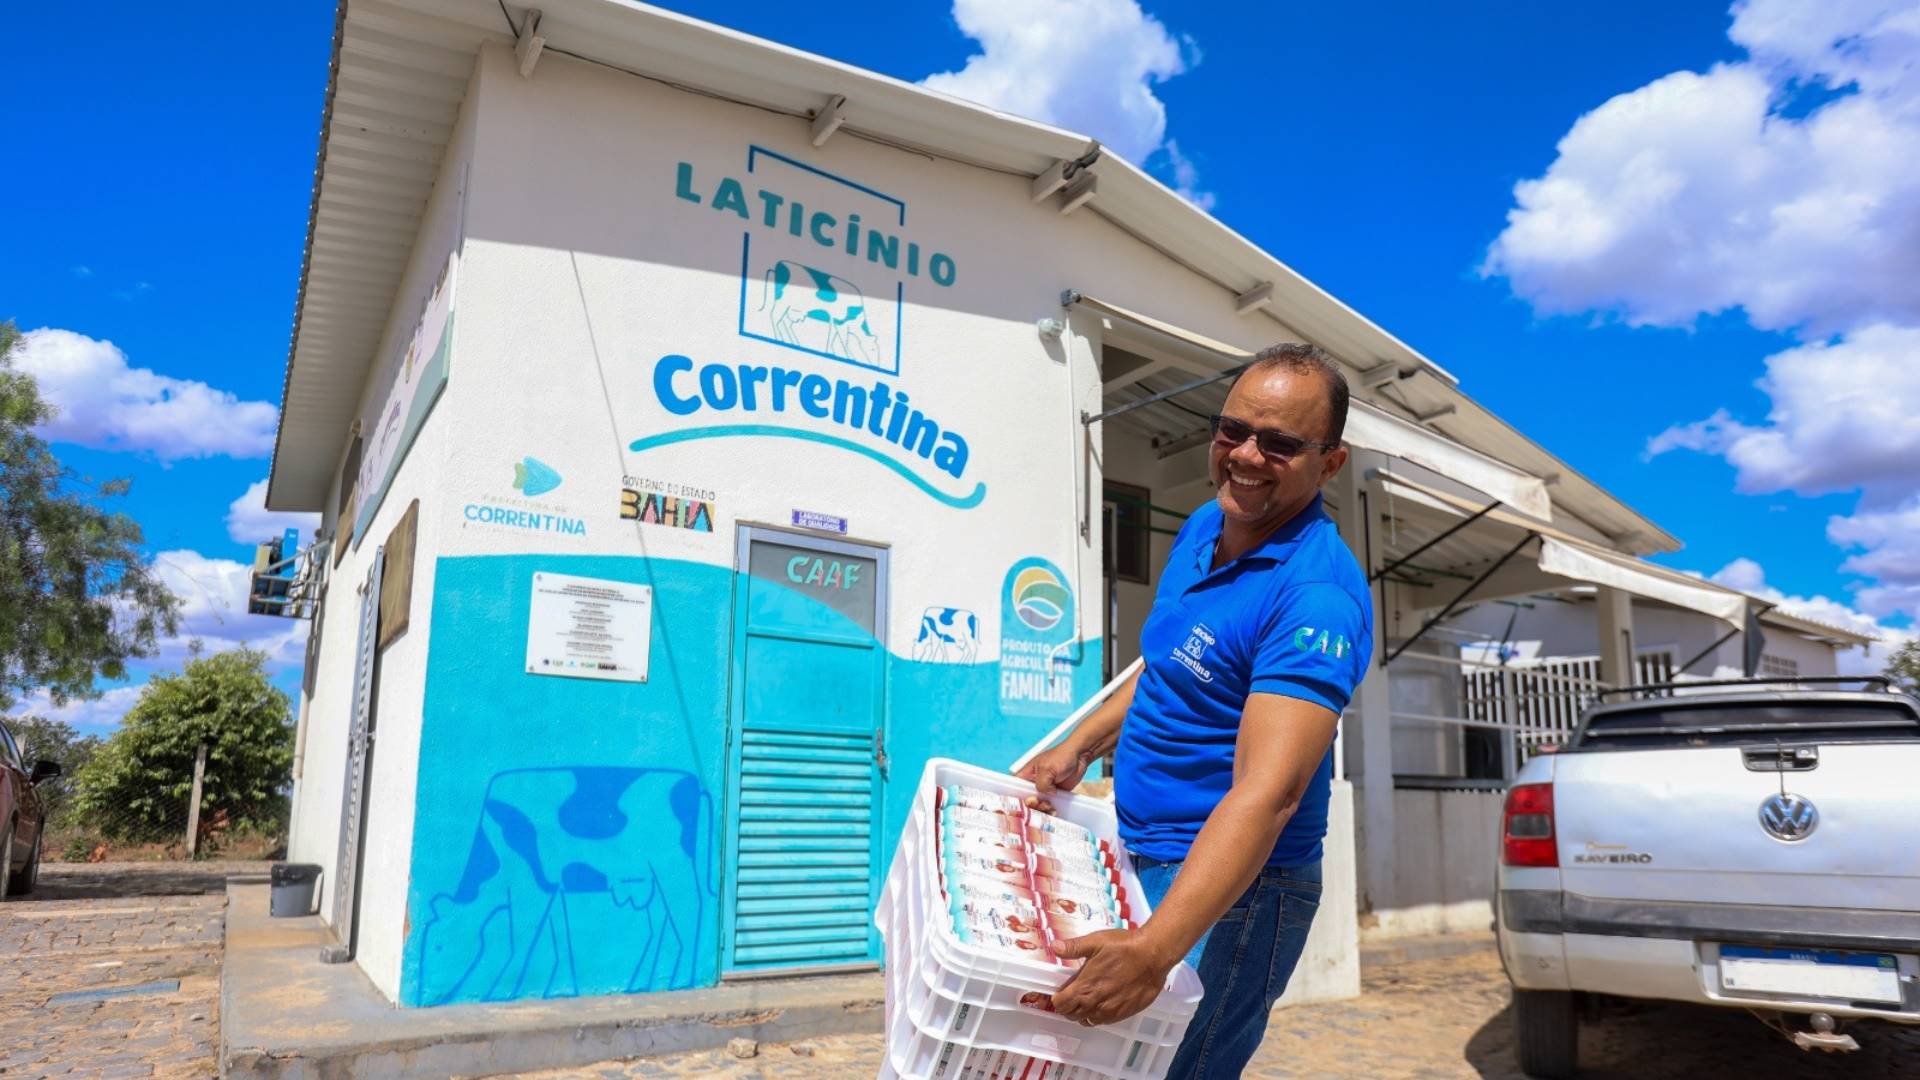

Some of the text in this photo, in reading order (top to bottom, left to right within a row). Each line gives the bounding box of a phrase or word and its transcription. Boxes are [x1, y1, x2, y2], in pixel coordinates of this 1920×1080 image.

[676, 162, 956, 287] LATICÍNIO
[653, 354, 969, 479] Correntina
[622, 474, 664, 491] GOVERNO
[681, 484, 716, 501] ESTADO
[463, 504, 587, 536] CORRENTINA
[619, 487, 715, 533] BAHIA
[787, 555, 862, 590] CAAF
[1002, 638, 1051, 655] PRODUTO
[1001, 671, 1073, 705] FAMILIAR
